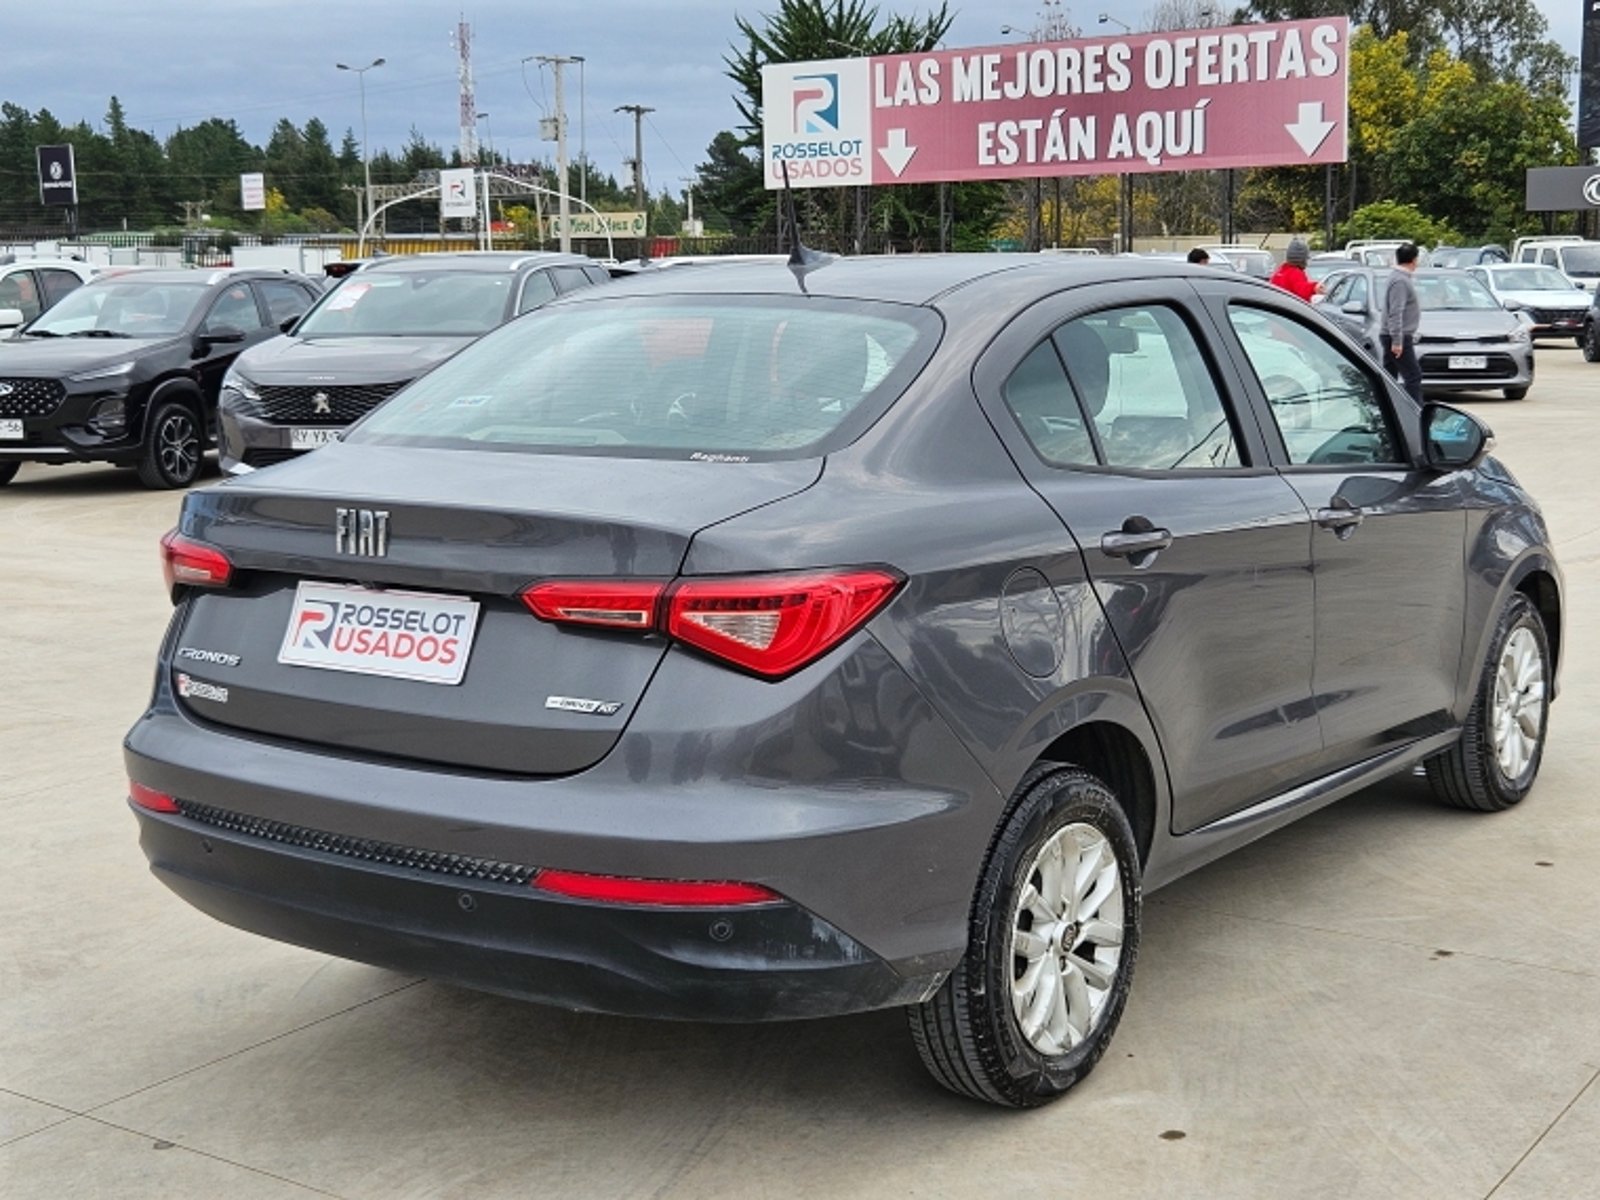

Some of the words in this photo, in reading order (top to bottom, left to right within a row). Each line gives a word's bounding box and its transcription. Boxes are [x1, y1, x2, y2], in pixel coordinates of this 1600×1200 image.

[875, 58, 941, 108] LAS
[953, 42, 1132, 102] MEJORES
[1144, 24, 1339, 90] OFERTAS
[978, 107, 1096, 166] ESTÁN
[1107, 98, 1212, 166] AQUÍ
[772, 140, 863, 159] ROSSELOT
[773, 157, 863, 180] USADOS
[336, 507, 390, 557] FIAT
[339, 603, 467, 636] ROSSELOT
[178, 647, 241, 666] CRONOS
[333, 630, 460, 665] USADOS
